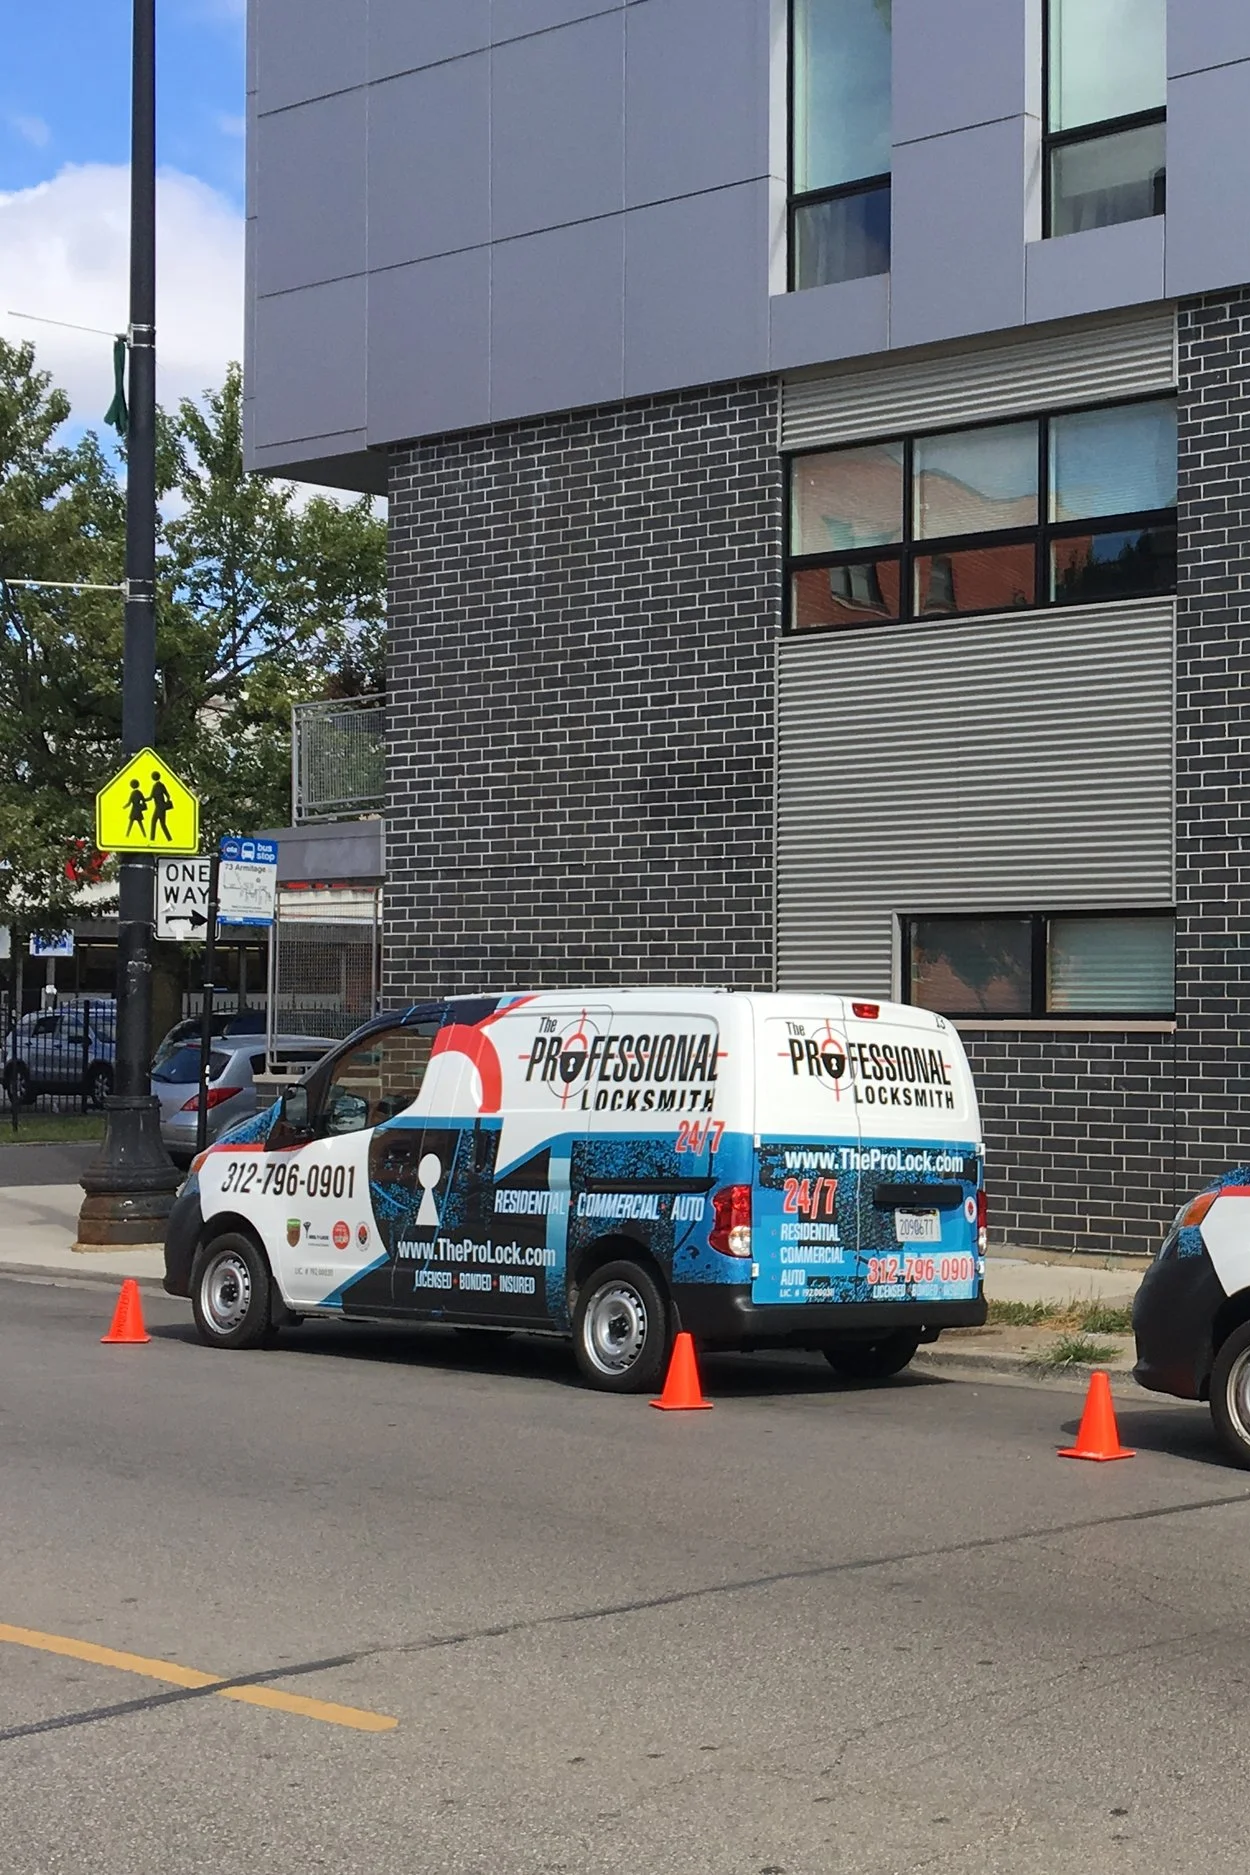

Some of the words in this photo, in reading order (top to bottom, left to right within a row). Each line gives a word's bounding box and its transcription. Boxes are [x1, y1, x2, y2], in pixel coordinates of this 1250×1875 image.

[256, 852, 276, 863] stop
[257, 843, 273, 852] bus
[166, 863, 210, 882] ONE
[225, 863, 234, 871] 73
[235, 864, 266, 874] Armitage
[164, 886, 210, 904] WAY
[539, 1015, 558, 1034] The
[785, 1021, 806, 1037] The
[525, 1033, 720, 1083] PROFESSIONAL
[788, 1038, 952, 1087] PROFESSIONAL
[581, 1088, 716, 1113] LOCKSMITH
[853, 1084, 955, 1110] LOCKSMITH
[675, 1118, 727, 1154] 24/7
[785, 1148, 963, 1173] www.TheProLock.com
[221, 1163, 357, 1198] 312-796-0901
[494, 1189, 567, 1216] RESIDENTIAL
[577, 1194, 661, 1220] COMMERCIAL
[671, 1197, 704, 1221] AUTO
[783, 1177, 838, 1219] 24/7
[780, 1224, 841, 1241] RESIDENTIAL
[399, 1237, 556, 1267] www.TheProLock.com
[780, 1246, 845, 1264] COMMERCIAL
[415, 1270, 453, 1290] LICENSED
[459, 1272, 493, 1292] BONDED
[499, 1275, 536, 1295] INSURED
[780, 1269, 806, 1286] AUTO
[867, 1256, 975, 1285] 312-796-0901
